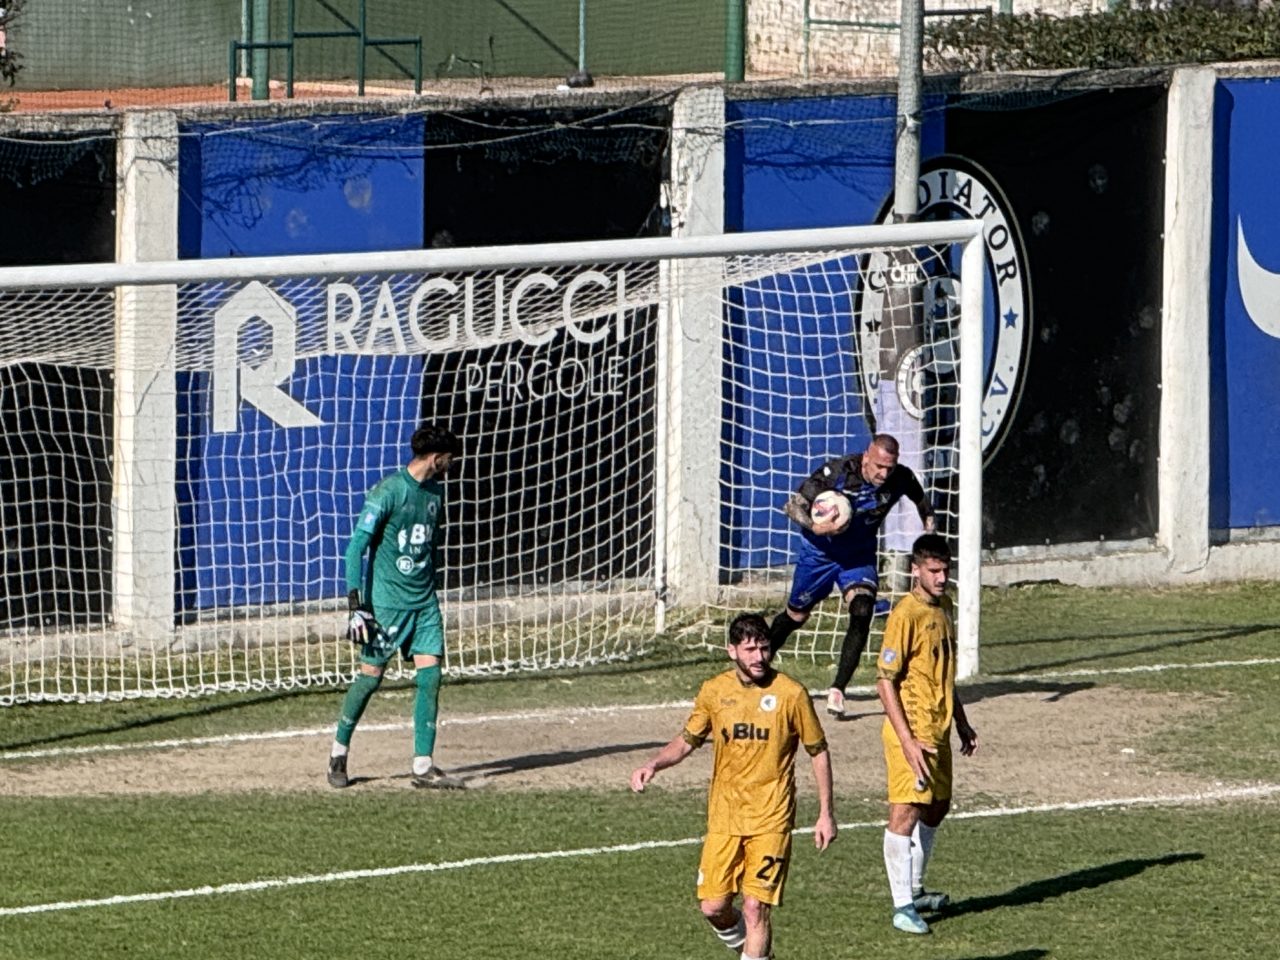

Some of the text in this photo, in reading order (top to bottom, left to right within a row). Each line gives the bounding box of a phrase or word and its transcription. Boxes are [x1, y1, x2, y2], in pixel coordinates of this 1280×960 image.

[326, 269, 626, 357] RAGUCCI
[465, 355, 625, 402] PERGOLE
[733, 722, 770, 741] Blu
[755, 855, 785, 884] 27
